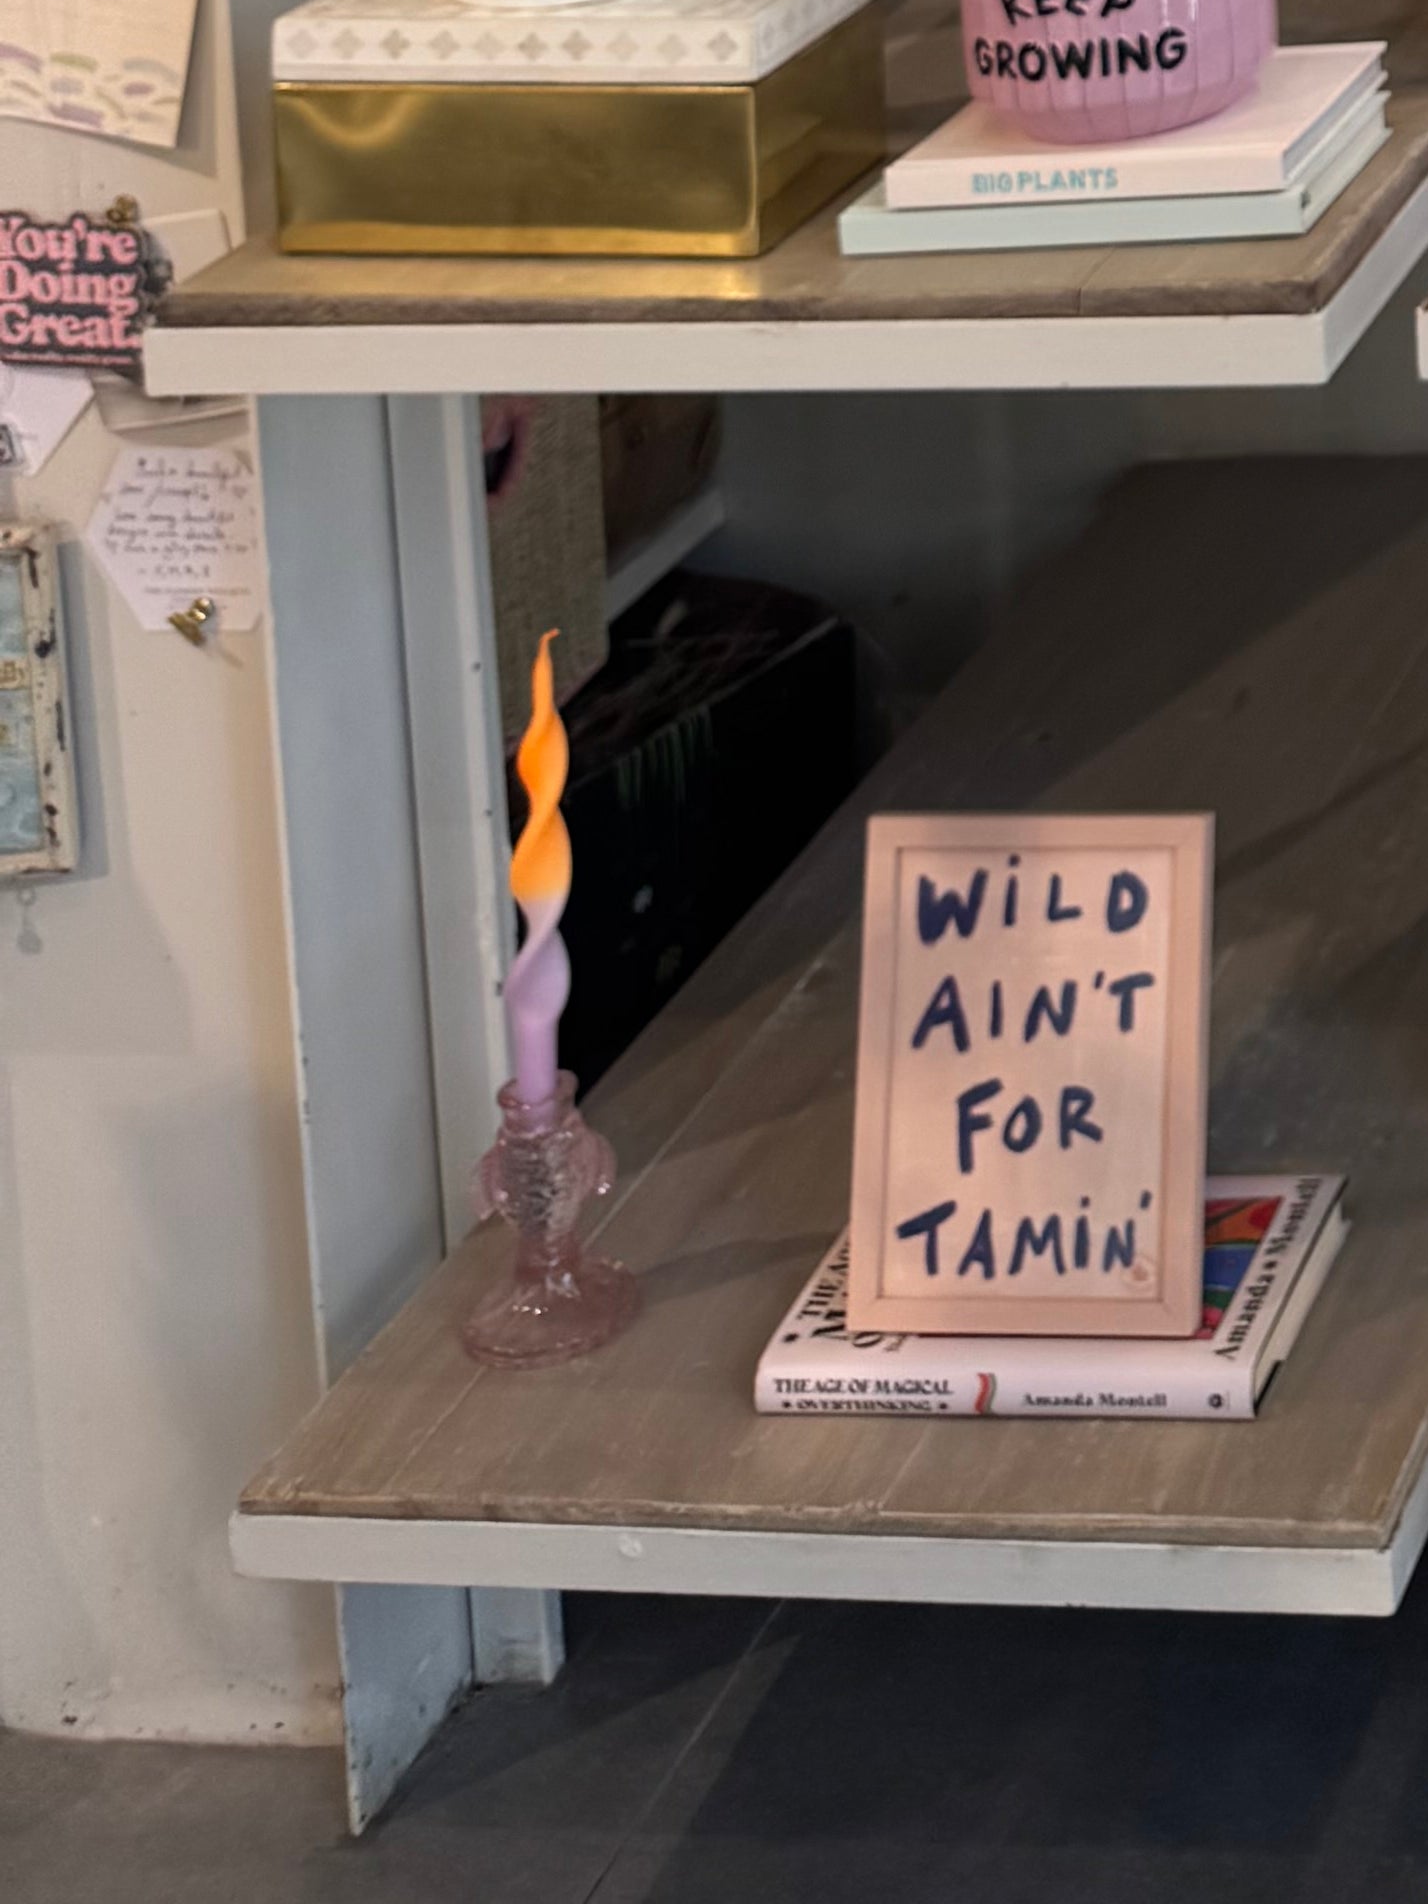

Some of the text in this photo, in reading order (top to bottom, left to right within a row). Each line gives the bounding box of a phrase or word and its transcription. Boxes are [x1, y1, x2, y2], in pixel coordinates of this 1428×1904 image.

[973, 26, 1189, 83] GROWING
[971, 167, 1119, 195] BIG PLANTS
[0, 259, 140, 317] Doing
[0, 302, 143, 349] Great.
[910, 970, 1155, 1053] AIN'T
[955, 1077, 1104, 1174] FOR
[1213, 1272, 1276, 1361] Amanda
[773, 1377, 954, 1394] THE AGE OF MAGICAL
[1023, 1392, 1168, 1408] Amanda Montell
